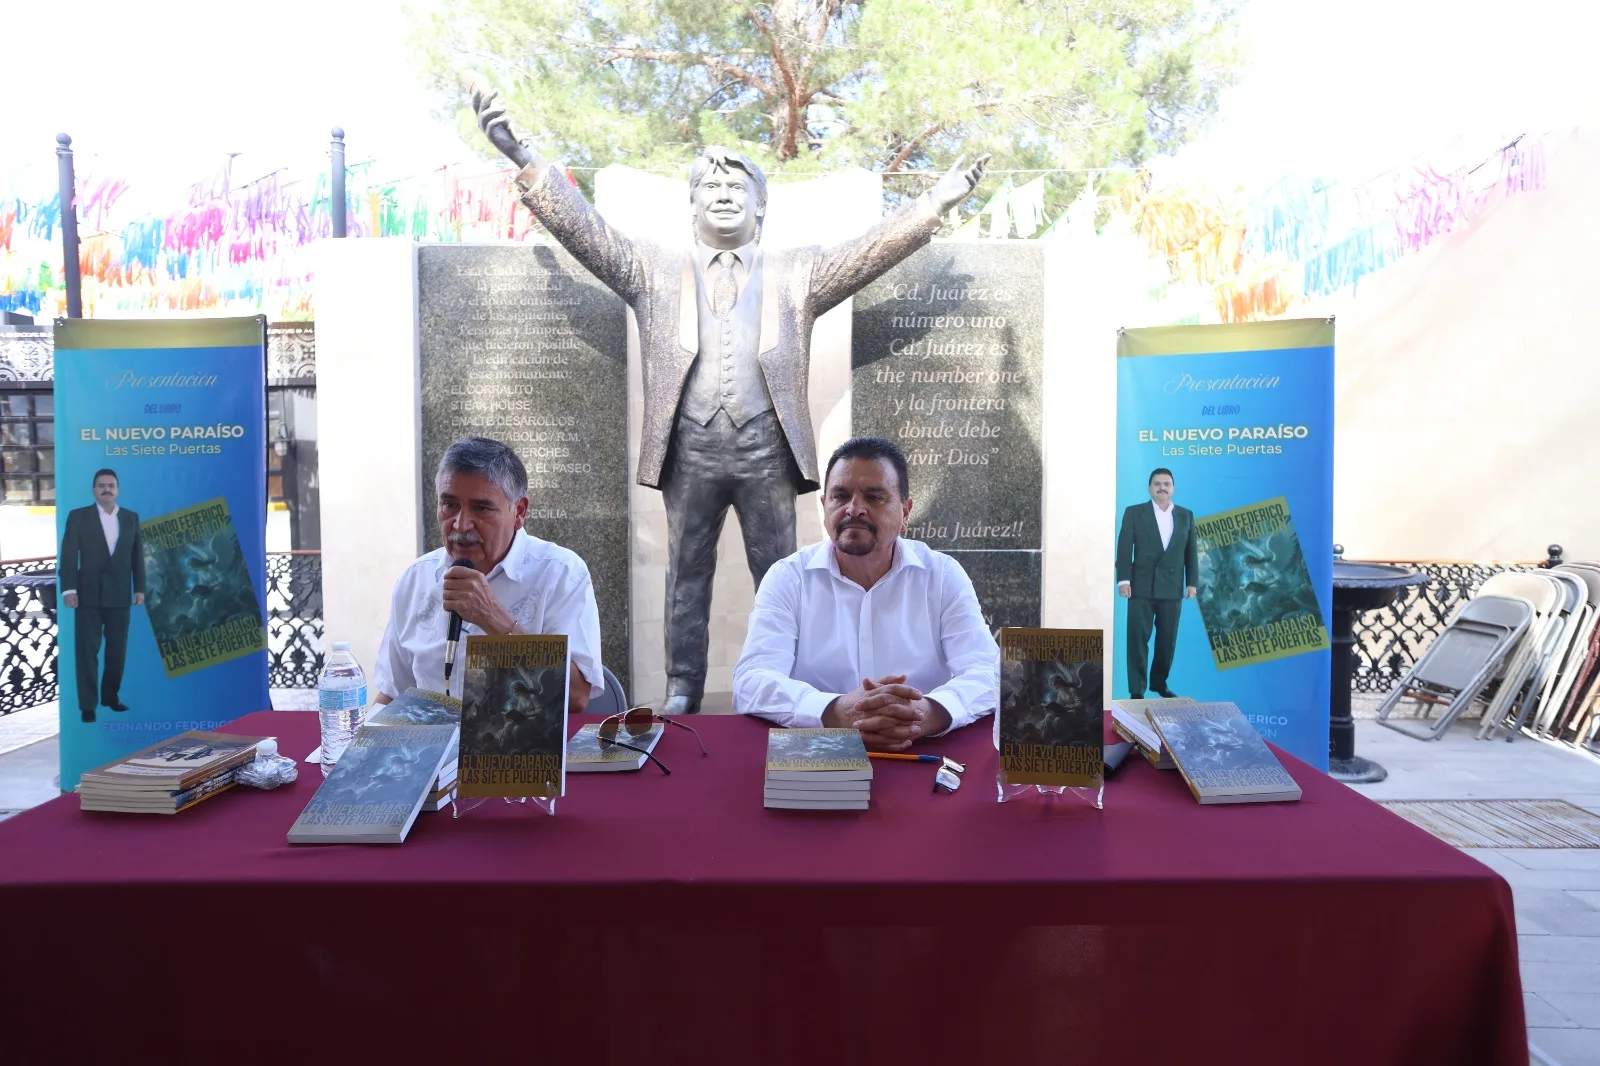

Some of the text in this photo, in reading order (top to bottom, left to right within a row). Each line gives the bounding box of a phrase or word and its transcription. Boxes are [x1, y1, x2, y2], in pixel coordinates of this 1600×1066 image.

[926, 281, 988, 305] Juárez
[994, 289, 1013, 302] es
[508, 310, 569, 324] siguientes
[891, 311, 1007, 329] número uno
[485, 338, 534, 350] hicieron
[537, 338, 581, 352] posible
[889, 336, 1009, 359] Cd. Juárez es
[485, 353, 550, 365] edificación
[553, 353, 569, 365] de
[107, 370, 218, 391] Presentación
[876, 366, 1023, 383] the number one
[466, 384, 534, 395] CORRALITO
[1164, 373, 1281, 395] Presentación
[144, 403, 182, 414] DEL LIBRO
[450, 400, 531, 411] STEAK HOUSE
[893, 394, 1005, 417] y la frontera
[1201, 404, 1241, 416] DEL LIBRO
[81, 423, 244, 441] EL NUEVO PARAÍSO
[898, 422, 1001, 439] donde debe
[1138, 423, 1309, 442] EL NUEVO PARAÍSO
[105, 442, 221, 456] Las Siete Puertas
[1162, 442, 1282, 456] Las Siete Puertas
[535, 463, 551, 474] EL
[552, 463, 592, 474] PASEO
[140, 504, 224, 542] RNANDO FEDERICO
[1194, 503, 1285, 539] RNANDO FEDERICO
[904, 520, 1023, 542] rriba Juárez!!
[162, 616, 258, 656] EL NUEVO PARAÍSO
[1212, 613, 1317, 650] EL NUEVO PARAÍSO
[471, 641, 565, 655] FERNANDO FEDERICO
[1005, 634, 1102, 649] FERNANDO FEDERICO
[1216, 628, 1322, 663] LAS SIETE PUERTAS
[165, 629, 262, 671] LAS SIETE PUERTAS
[102, 720, 232, 732] FERNANDO FEDERIC
[1243, 714, 1288, 726] ERICO
[1004, 744, 1017, 758] EL
[1019, 744, 1051, 759] NUEVO
[462, 754, 475, 769] EL
[477, 754, 512, 769] NUEVO
[1004, 757, 1101, 775] LAS SIETE PUERTAS
[461, 769, 559, 785] LAS SIETE PUERTAS
[1196, 775, 1293, 789] LAS SIETE PUERTAS
[323, 804, 363, 815] NUEVO
[301, 813, 407, 825] LAS SIETE PUERTAS
